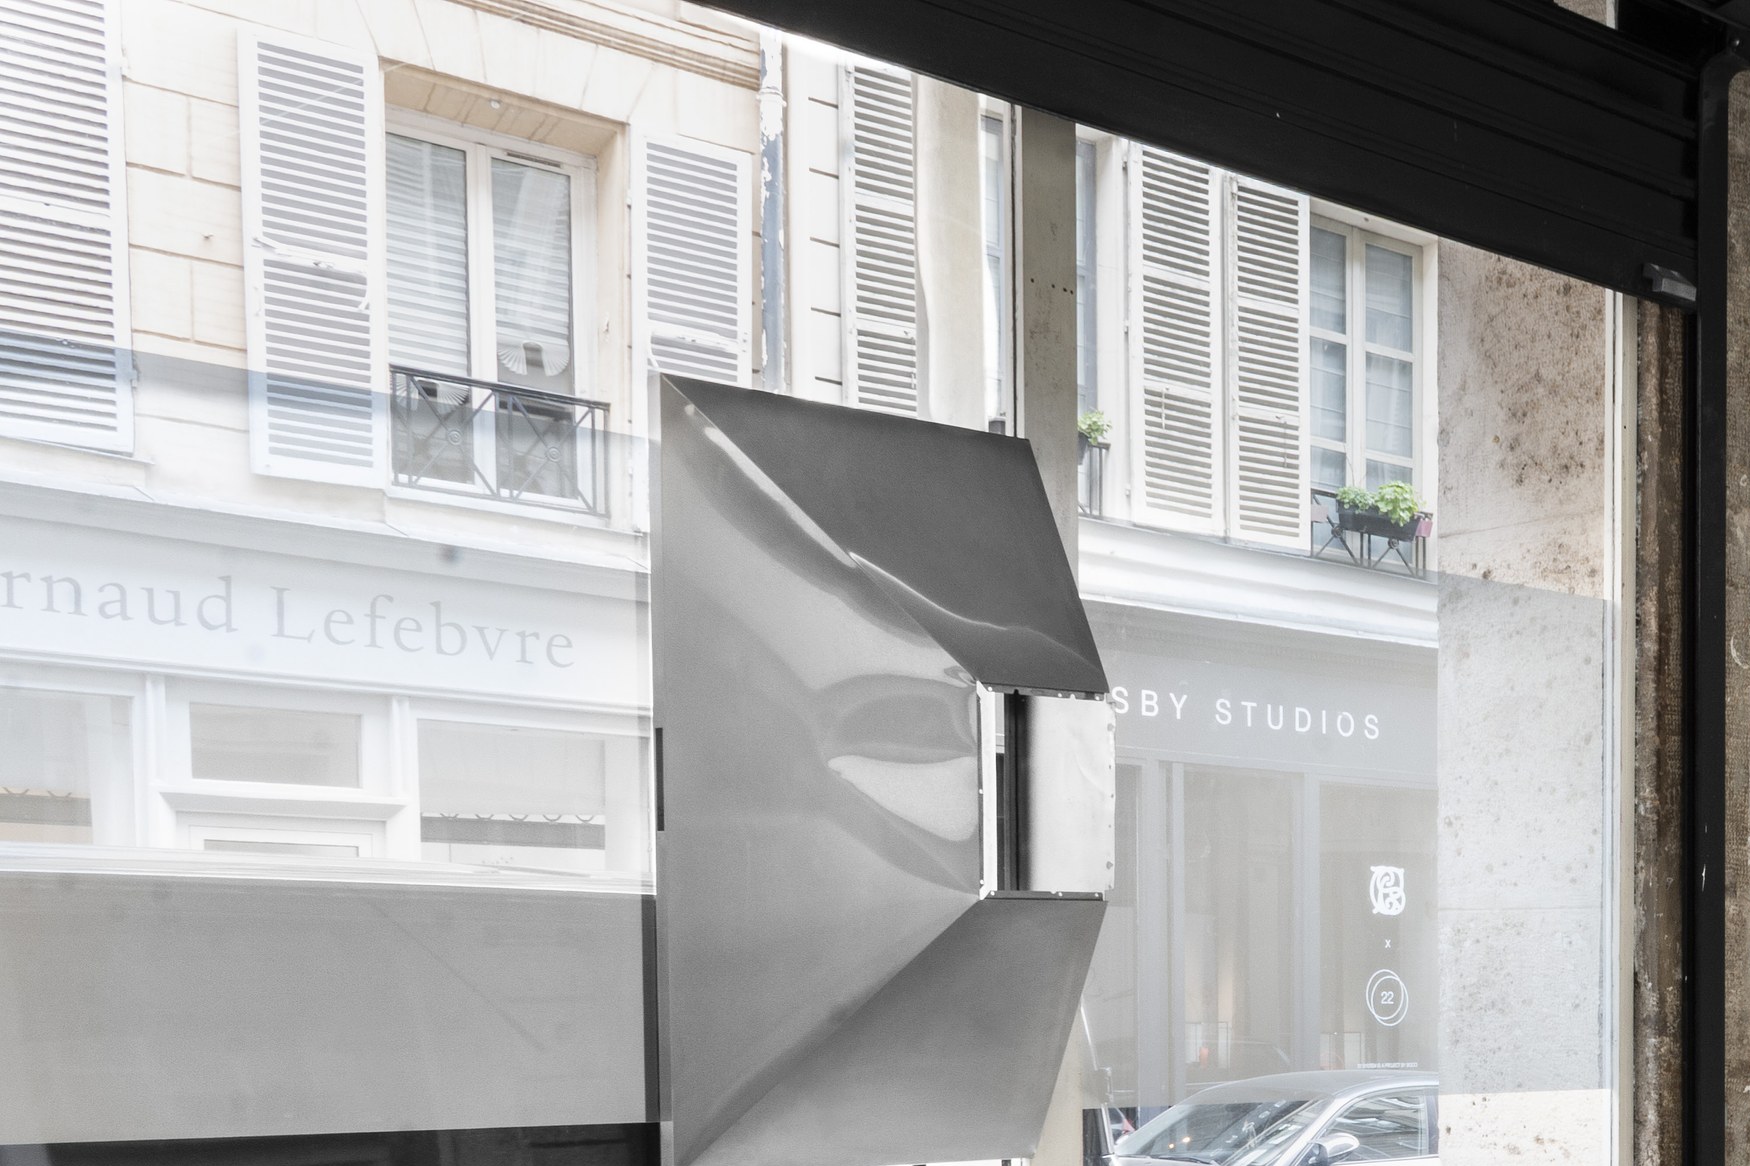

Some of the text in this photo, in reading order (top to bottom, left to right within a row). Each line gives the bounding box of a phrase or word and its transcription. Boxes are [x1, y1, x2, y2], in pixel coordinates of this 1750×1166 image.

[269, 585, 575, 668] Lefebvre
[1214, 698, 1380, 740] STUDIOS
[1380, 991, 1395, 1005] 22
